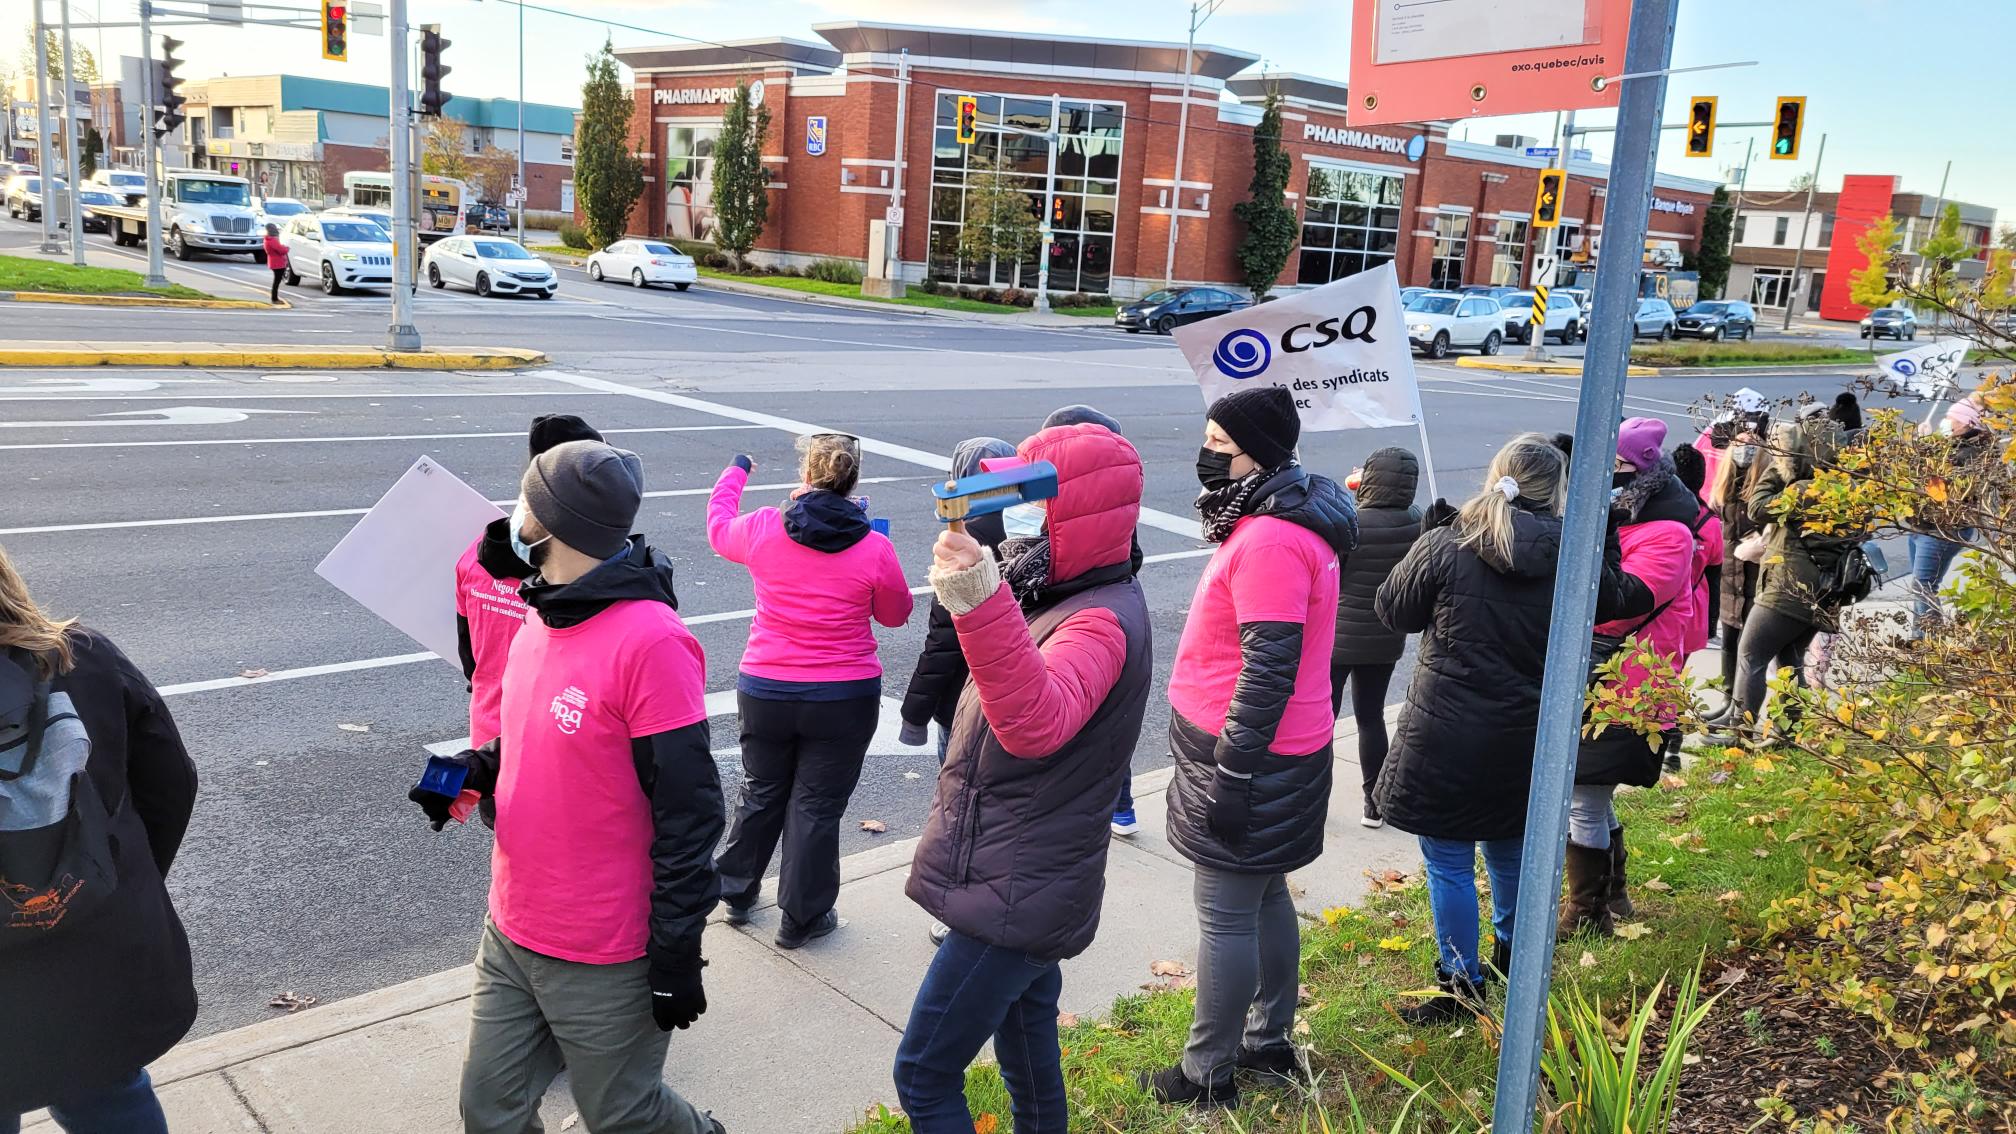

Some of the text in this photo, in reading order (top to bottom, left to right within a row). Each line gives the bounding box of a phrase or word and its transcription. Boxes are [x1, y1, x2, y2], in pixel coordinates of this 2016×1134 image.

[1511, 54, 1605, 73] exo.quebec/avis
[1303, 123, 1407, 154] PHARMAPRIX
[1280, 305, 1377, 354] CSQ
[1292, 377, 1319, 391] des
[1321, 368, 1390, 391] syndicats
[491, 579, 514, 595] Négos
